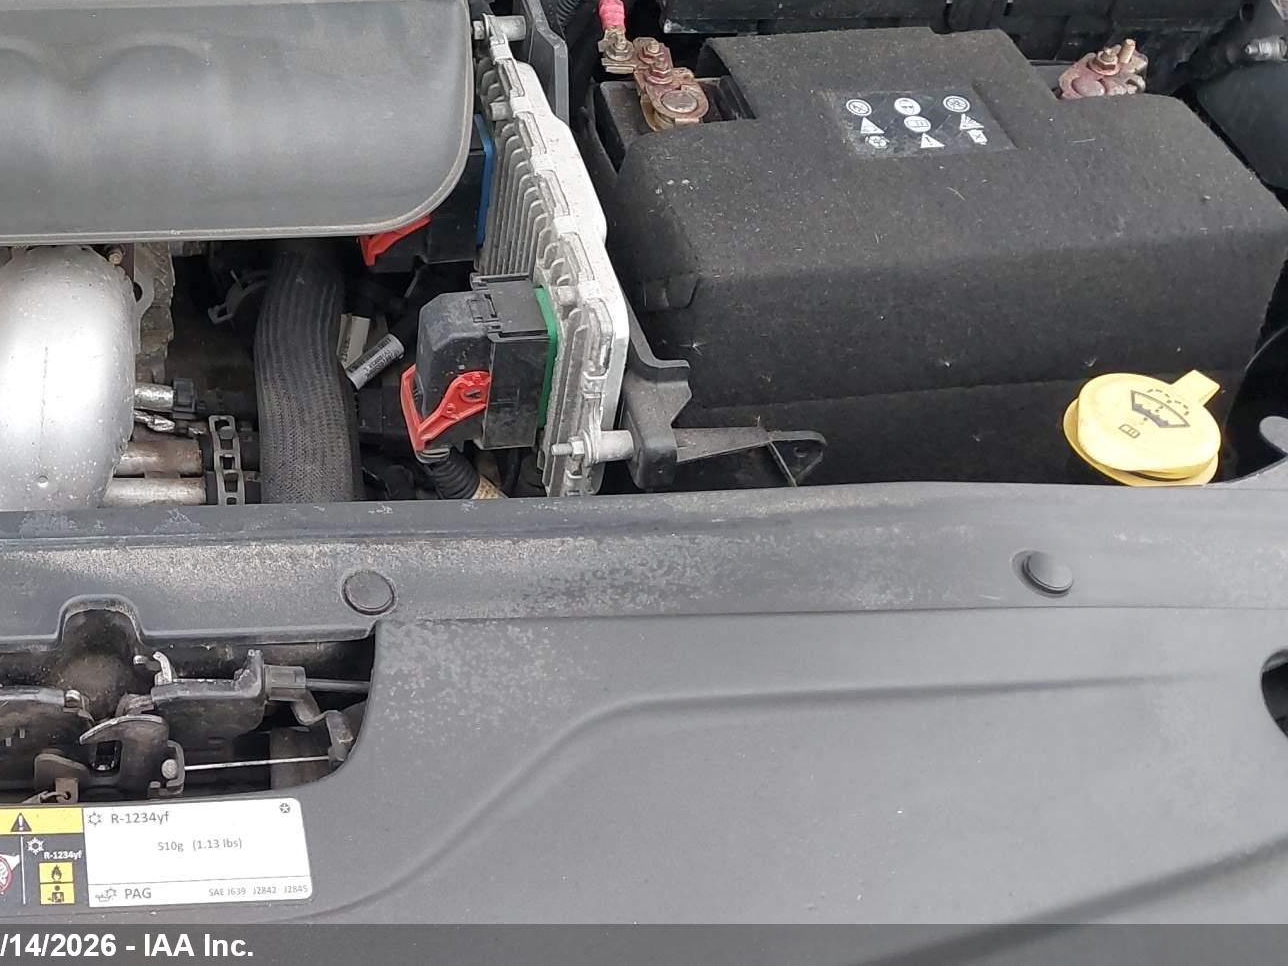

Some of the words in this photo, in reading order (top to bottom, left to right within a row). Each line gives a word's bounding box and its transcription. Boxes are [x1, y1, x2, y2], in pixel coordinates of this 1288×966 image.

[111, 810, 170, 826] R-1234yf
[192, 839, 220, 851] (1.13
[222, 837, 243, 850] lbs)
[43, 849, 83, 861] R-1234yf
[124, 886, 152, 900] PAG
[208, 887, 225, 897] SAE
